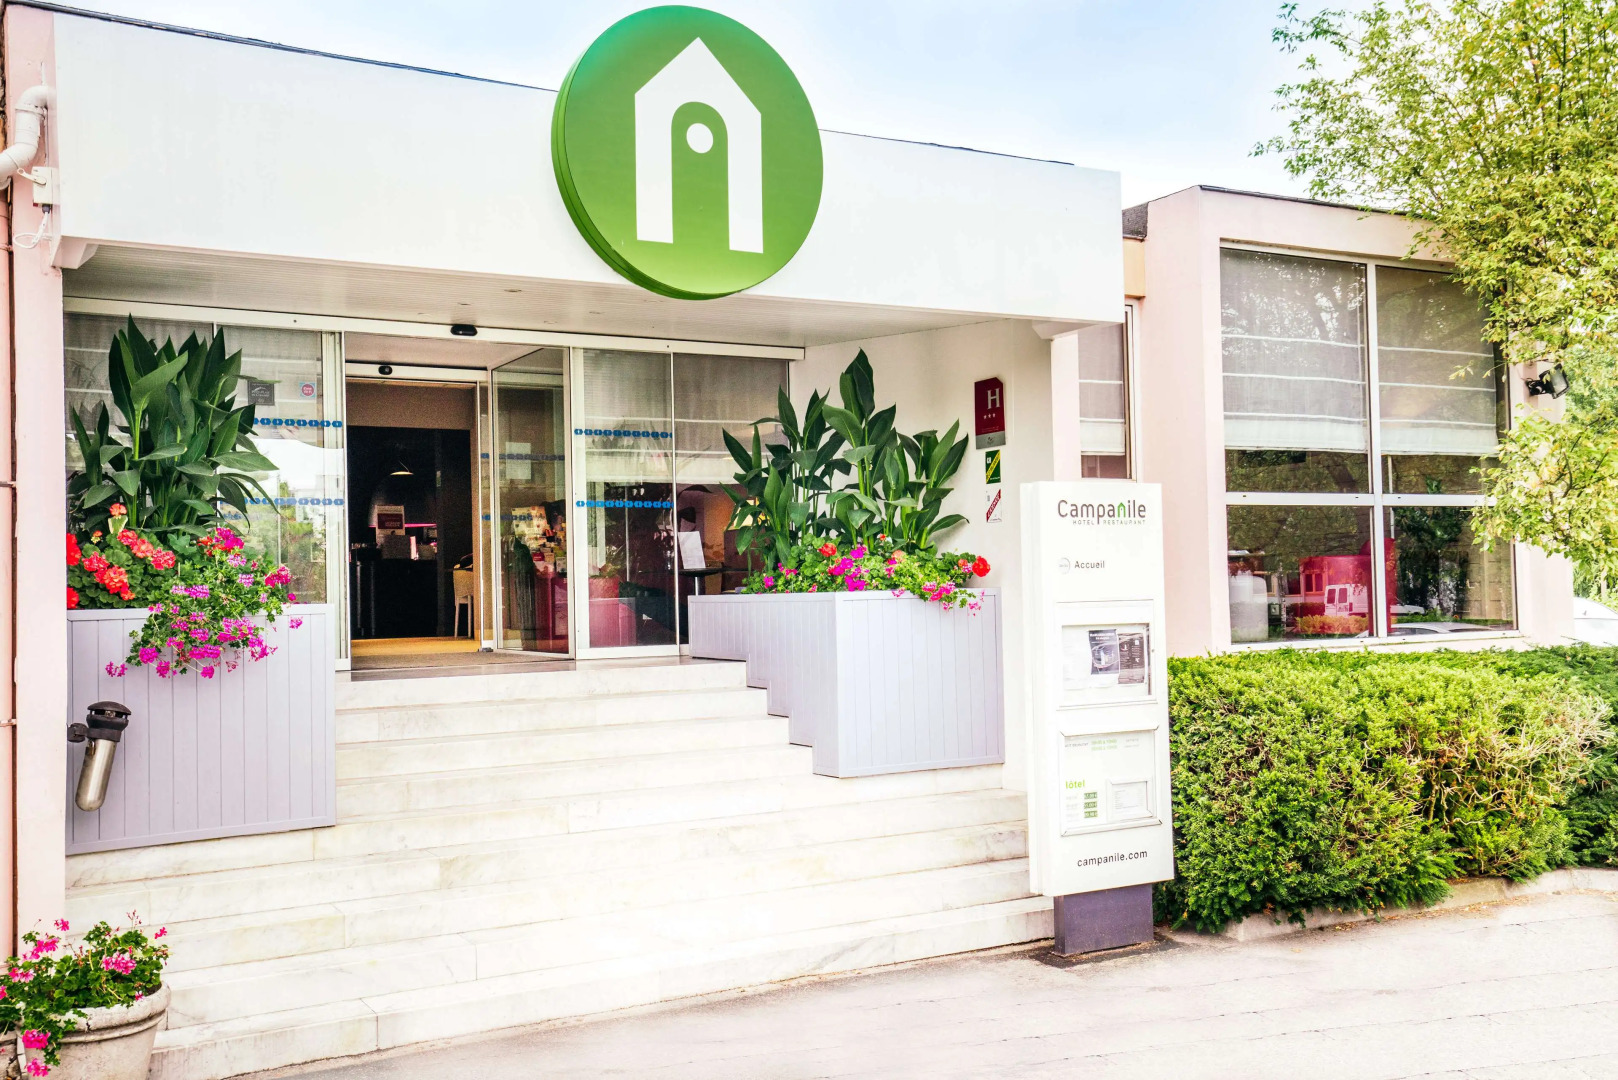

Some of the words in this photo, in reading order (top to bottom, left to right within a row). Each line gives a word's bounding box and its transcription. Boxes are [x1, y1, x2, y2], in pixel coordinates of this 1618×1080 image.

[987, 387, 1000, 410] H
[1057, 499, 1146, 525] Campanile
[1074, 560, 1105, 569] Accueil
[1077, 850, 1148, 867] campanile.com
